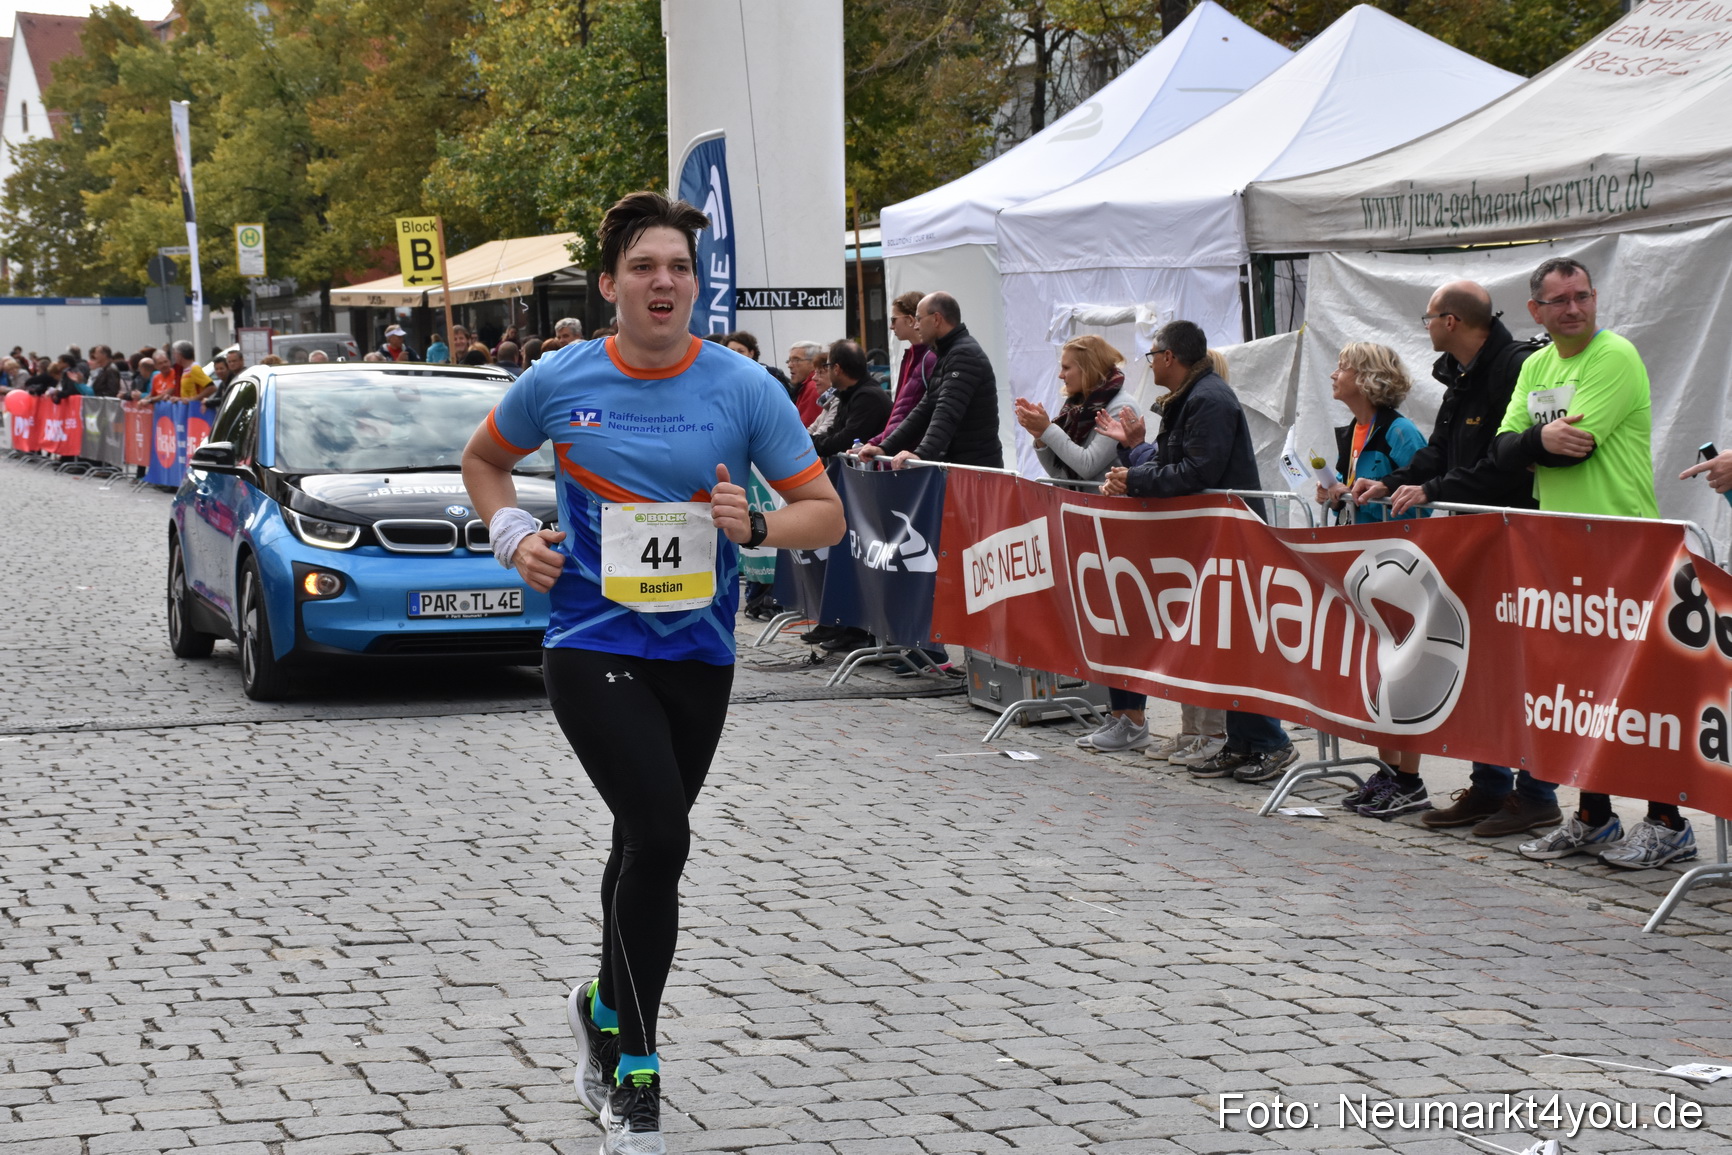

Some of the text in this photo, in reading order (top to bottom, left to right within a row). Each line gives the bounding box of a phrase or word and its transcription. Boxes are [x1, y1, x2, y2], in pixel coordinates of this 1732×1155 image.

[402, 220, 438, 233] Block
[410, 238, 435, 271] B
[608, 421, 714, 433] Neumarkt i.d.OPf. eG
[609, 411, 685, 423] Raiffeisenbank
[647, 513, 686, 522] BOCK
[641, 536, 682, 569] 44
[972, 535, 1046, 598] DAS NEUE
[640, 581, 683, 594] Bastian
[421, 592, 521, 612] PAR TL 4E
[1518, 576, 1654, 641] meisten
[1524, 684, 1680, 751] schönsten
